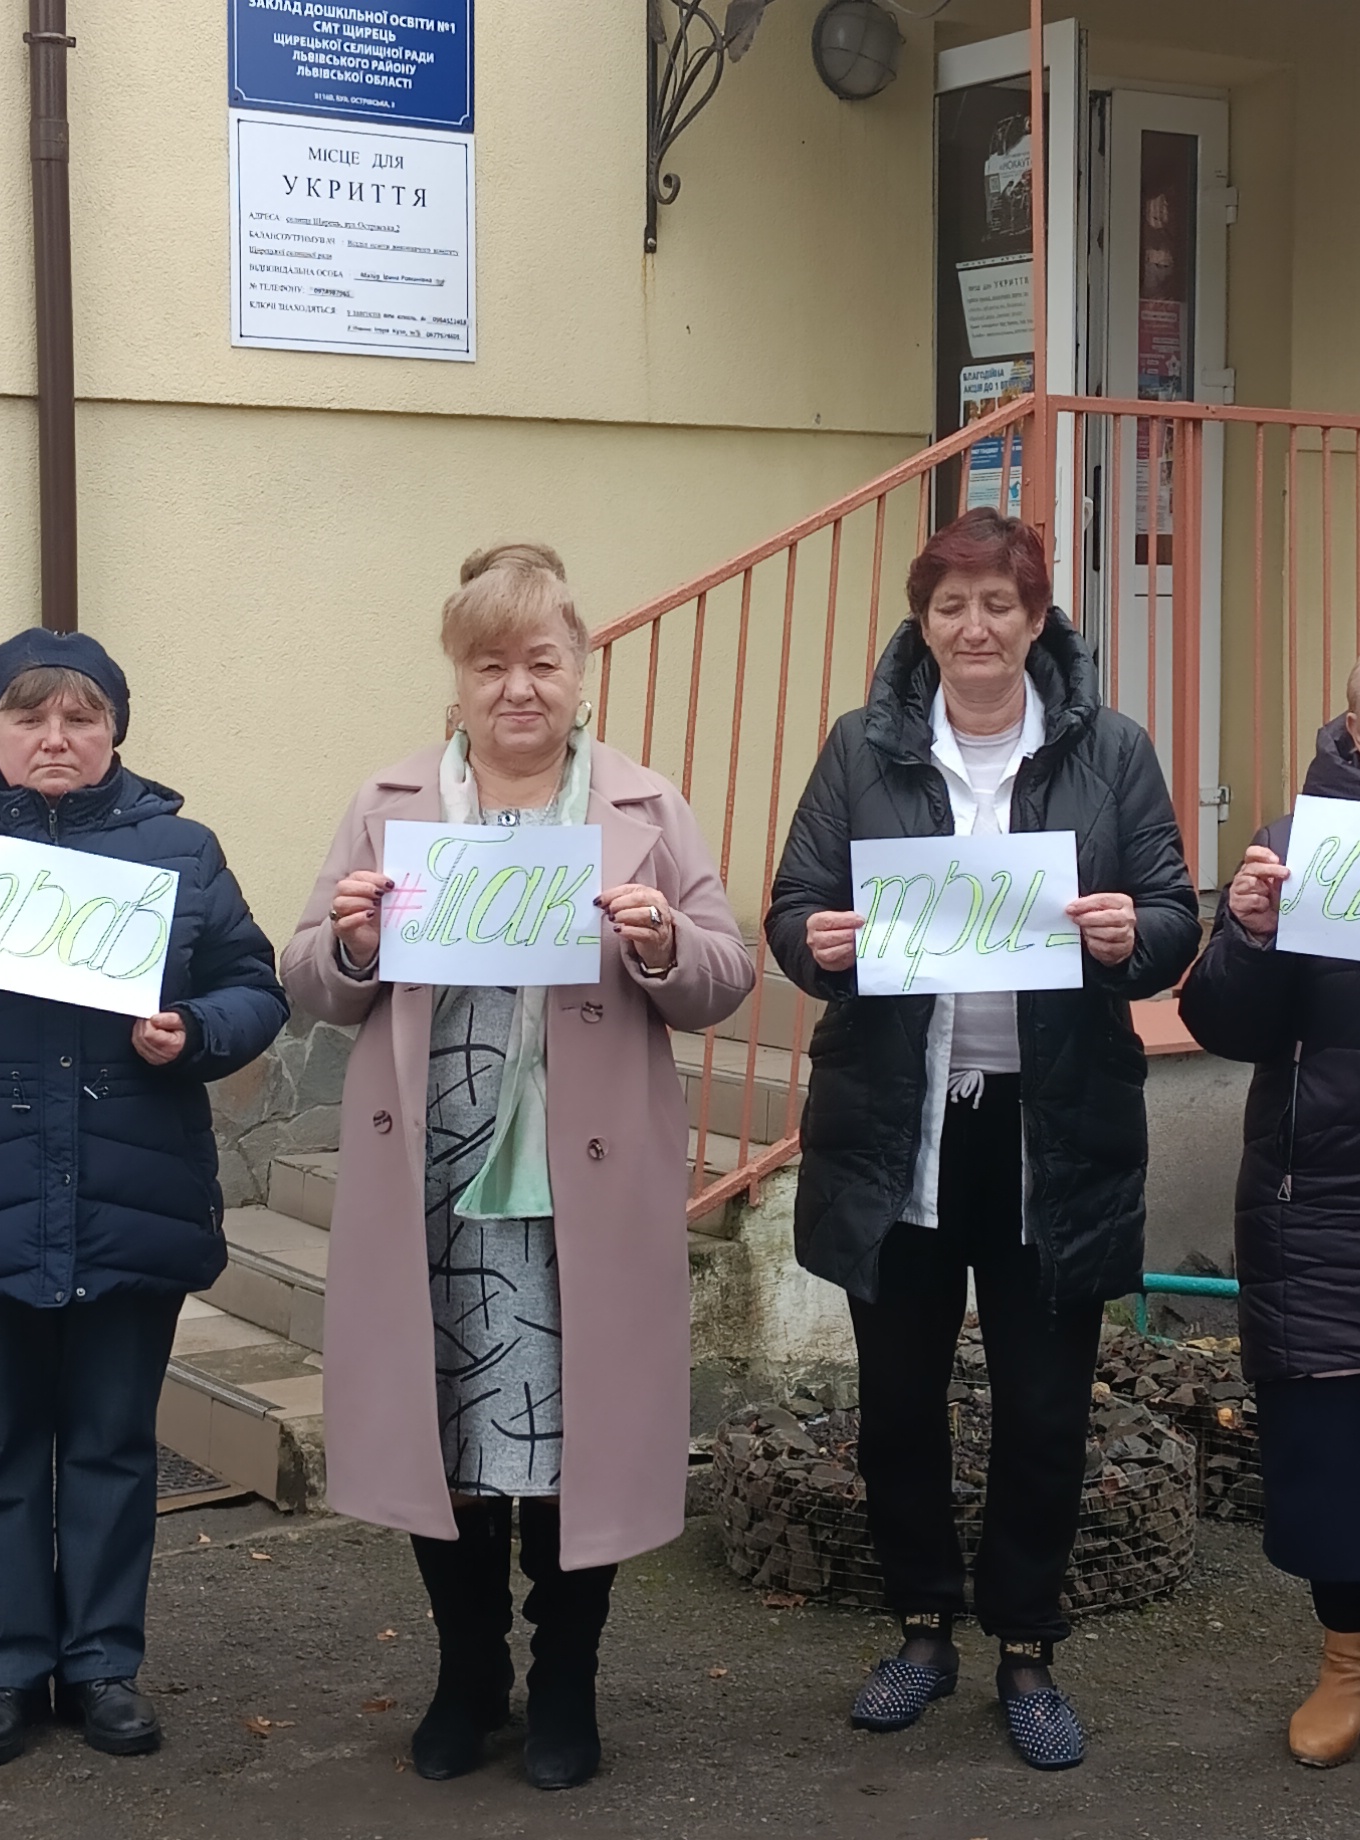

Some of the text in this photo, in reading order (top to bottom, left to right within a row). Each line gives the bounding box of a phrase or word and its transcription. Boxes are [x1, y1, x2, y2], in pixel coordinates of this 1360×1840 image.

[248, 0, 456, 35] ЗАКЛАД ДОШКІЛЬНОЇ ОСВІТИ №1
[312, 20, 397, 43] СМТ ЩИРЕЦЬ
[273, 32, 435, 64] ЩИРЕЦЬКОЇ СЕЛИЩНОЇ РАДИ
[292, 50, 417, 76] ЛЬВІВСЬКОГО РАЙОНУ
[296, 64, 413, 90] ЛЬВІВСЬКОЇ ОБЛАСТІ
[308, 146, 404, 170] МІСЦЕ ДЛЯ
[282, 174, 428, 208] УКРИТТЯ
[249, 211, 280, 222] АДРЕСА
[316, 268, 344, 278] ОСОБА
[249, 300, 276, 311] КЛЮЧІ
[983, 381, 994, 393] ДО
